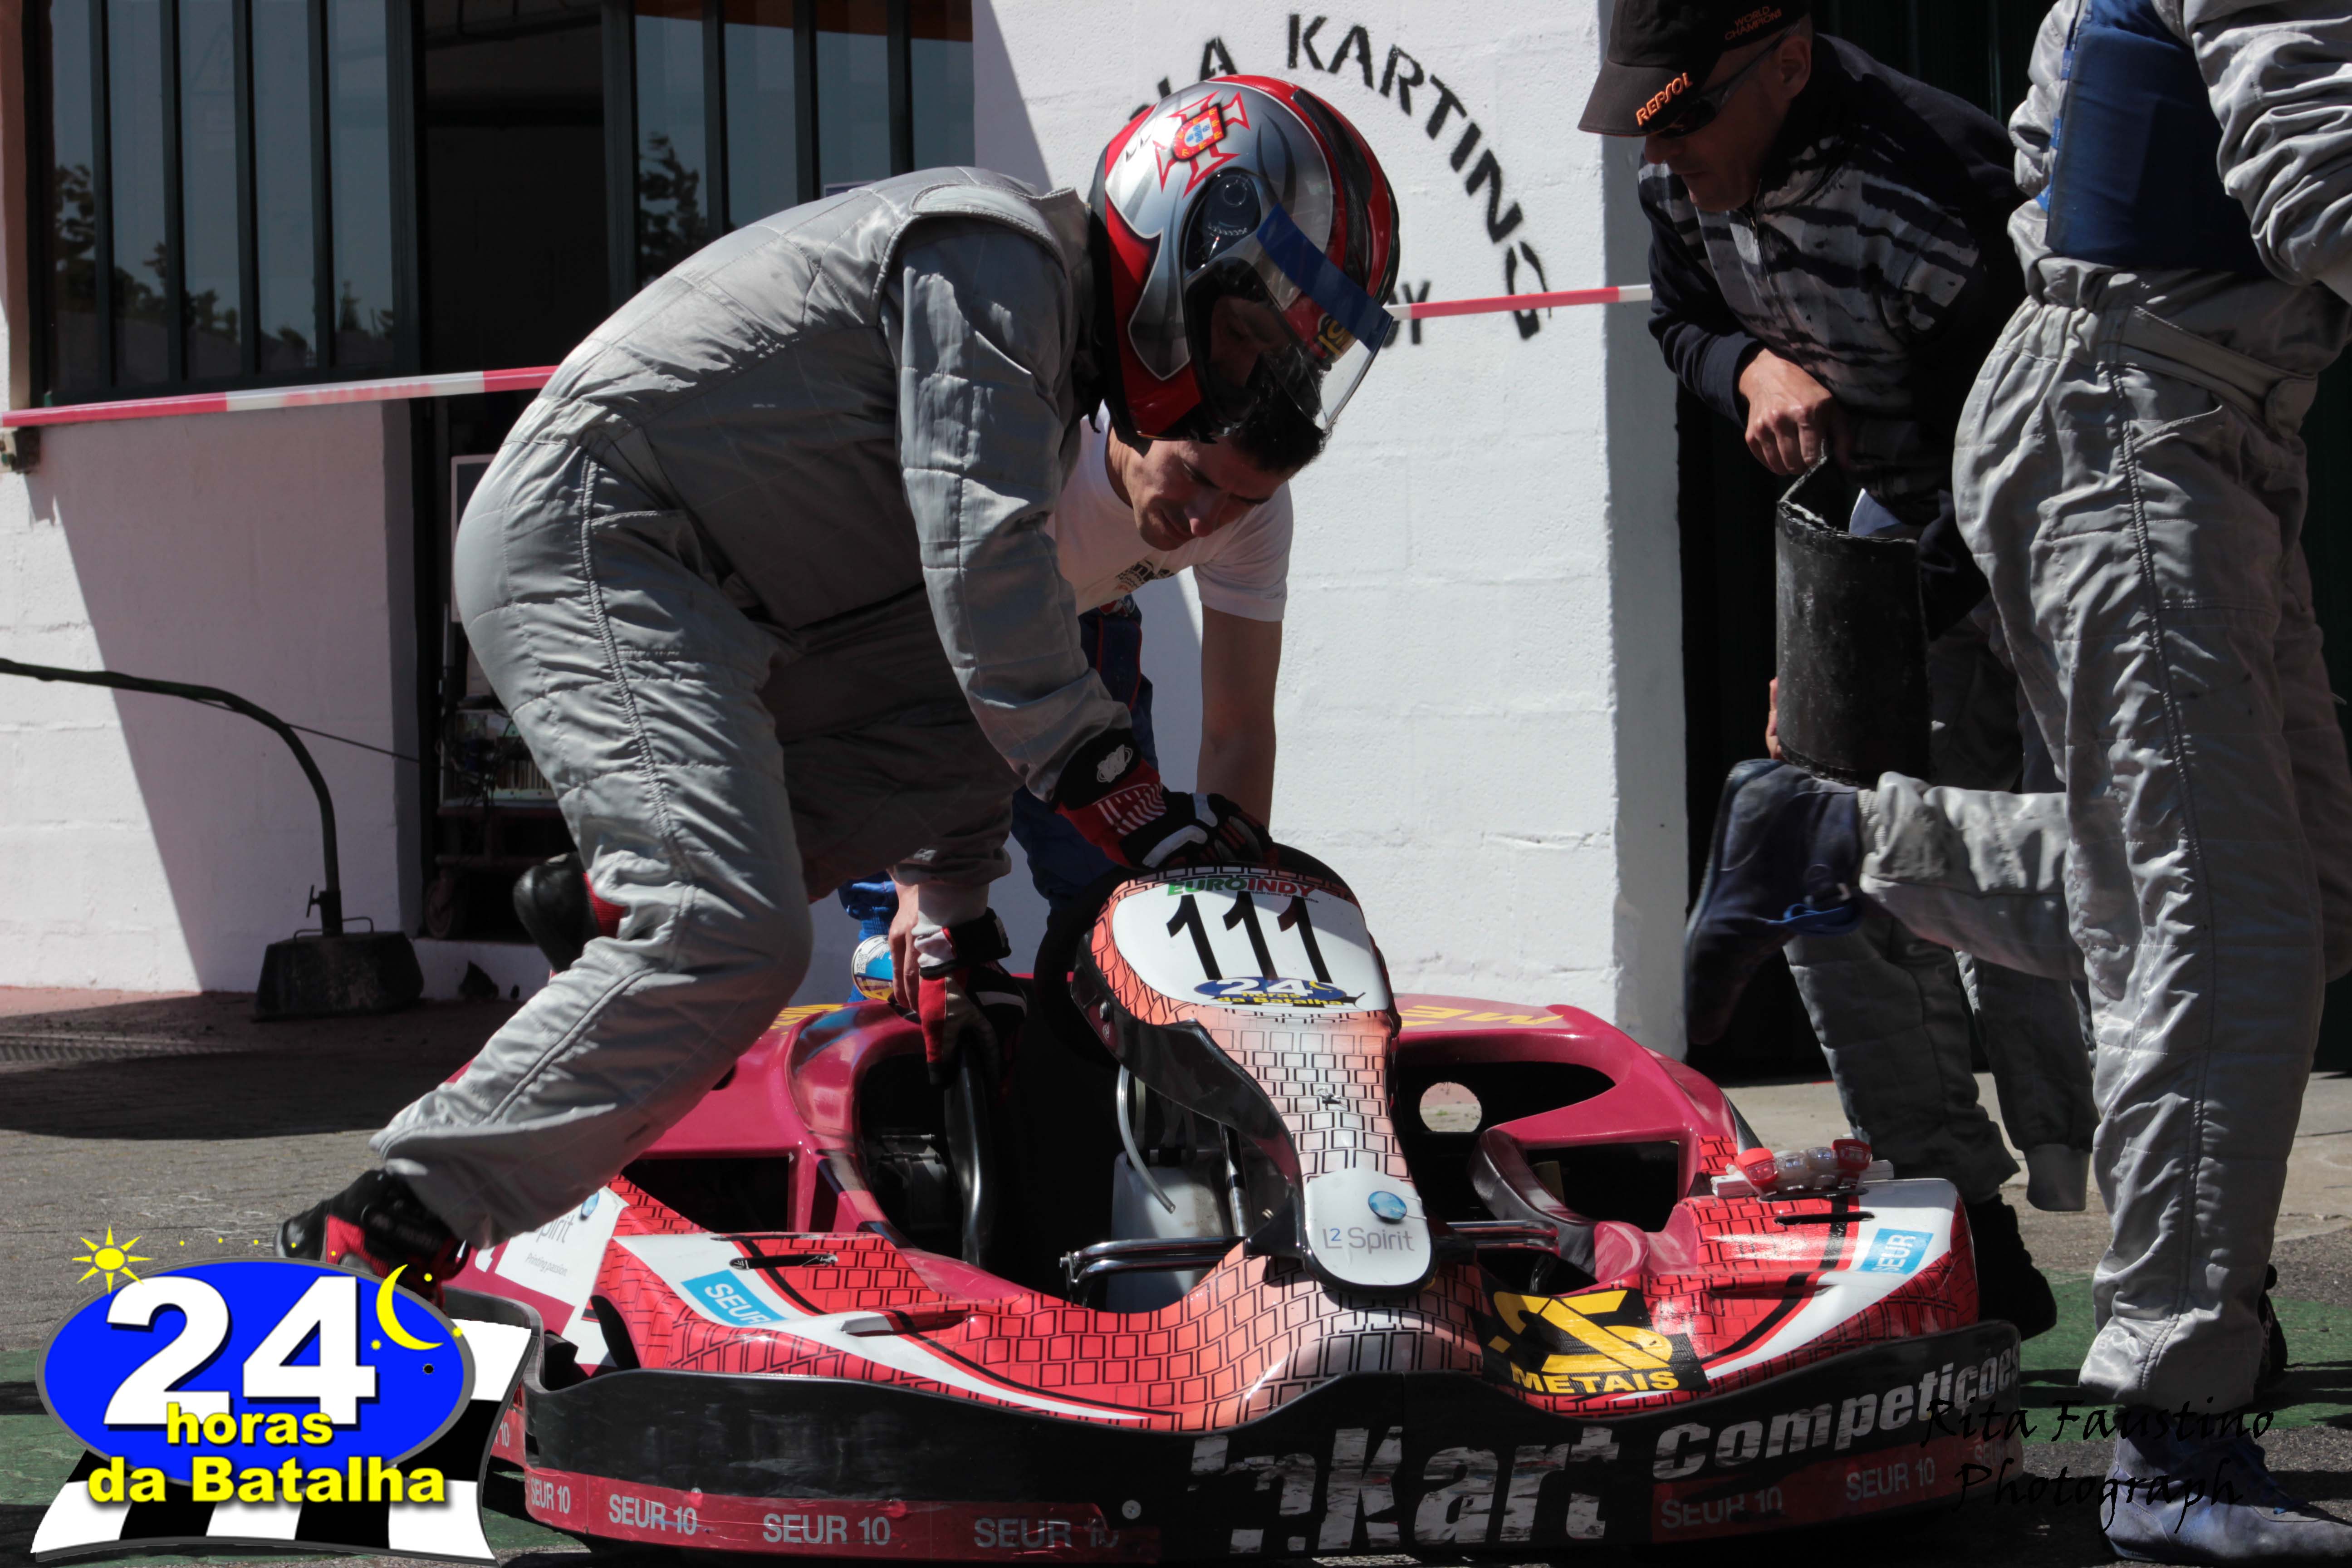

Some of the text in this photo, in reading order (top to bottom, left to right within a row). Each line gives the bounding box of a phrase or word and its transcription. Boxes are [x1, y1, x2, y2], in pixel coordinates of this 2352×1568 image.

[1725, 8, 1782, 41] CHAMPIONS
[1735, 6, 1770, 27] WORLD
[1636, 72, 1693, 127] REPSOL
[1167, 878, 1315, 896] EUROINDY
[1166, 891, 1333, 983] 111
[1216, 978, 1313, 997] 24
[1253, 997, 1344, 1005] Batalha
[1348, 1226, 1415, 1254] Spirit
[1872, 1235, 1916, 1272] SEUR
[705, 1283, 771, 1324] SEUR
[1509, 1362, 1679, 1394] METAIS
[530, 1477, 571, 1514] SEUR 10
[1845, 1457, 1935, 1501] SEUR 10
[608, 1494, 697, 1535] SEUR 10
[763, 1513, 891, 1545] SEUR 10
[1661, 1496, 1745, 1529] SEUR
[973, 1518, 1072, 1548] SEUR
